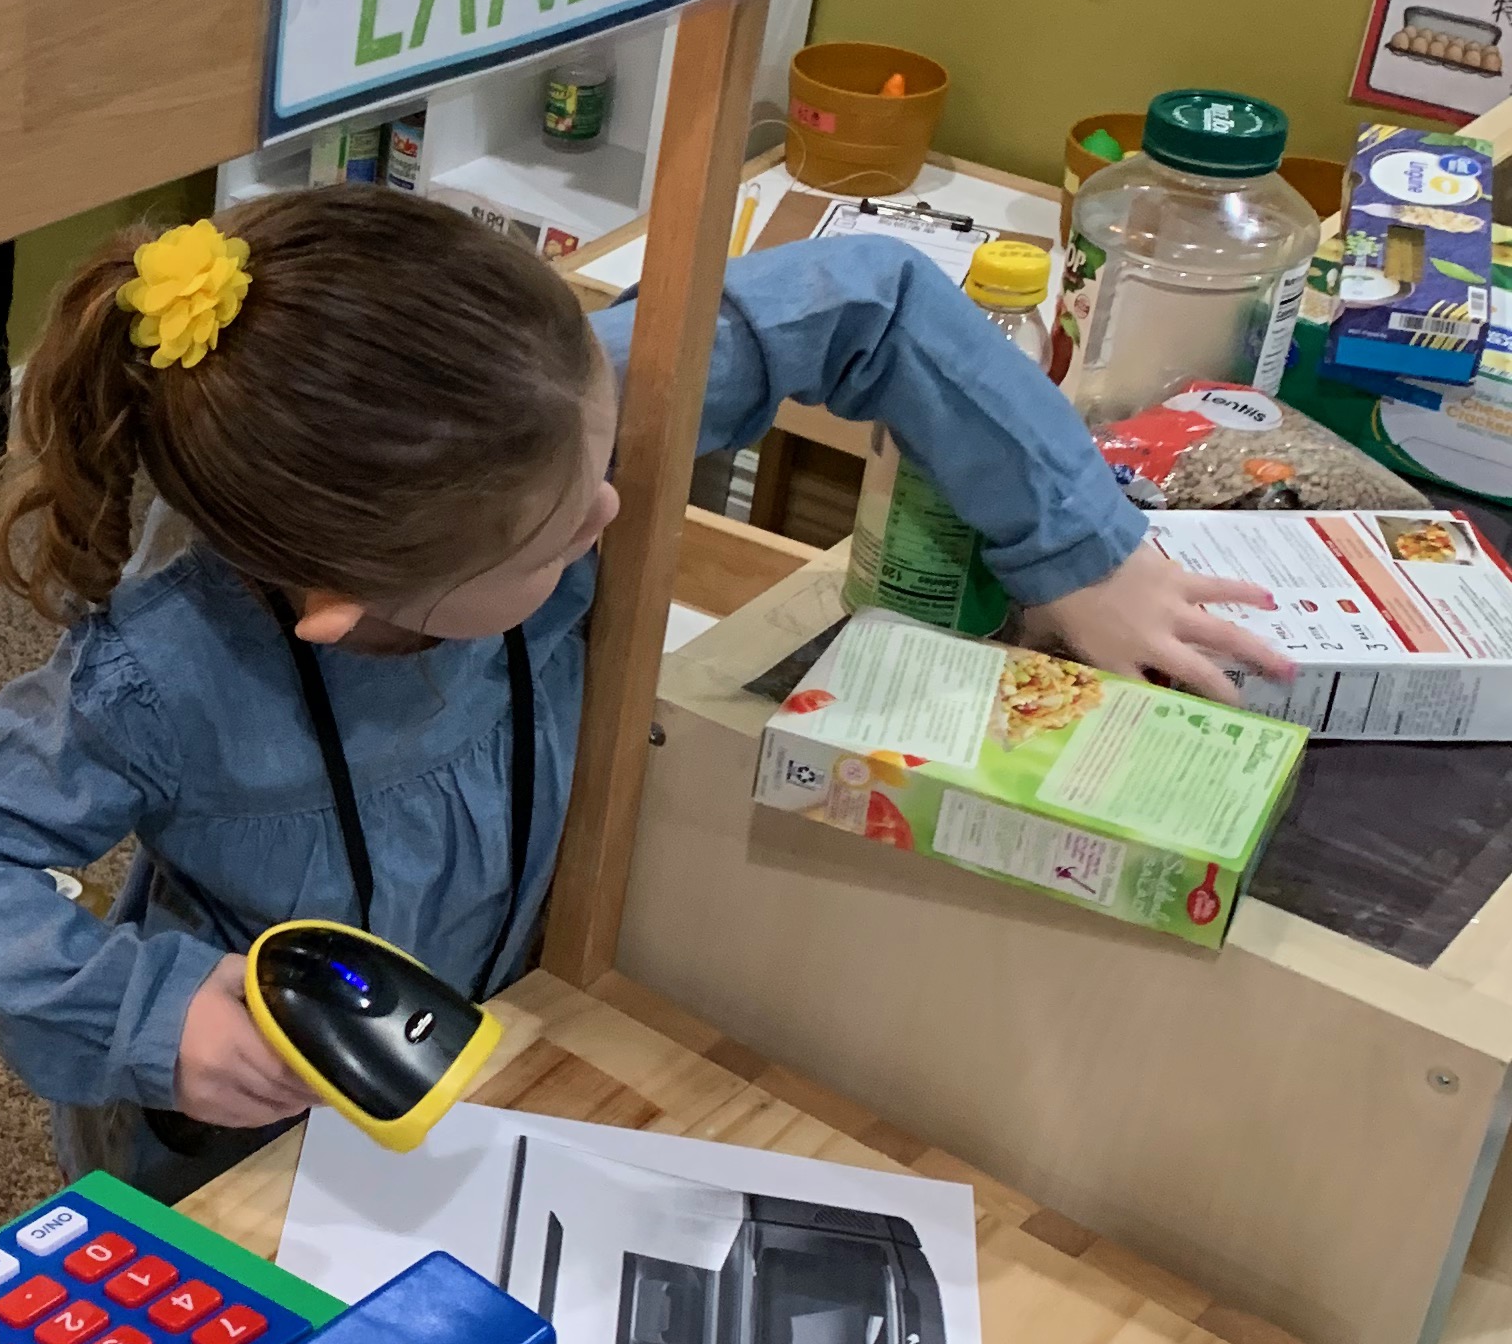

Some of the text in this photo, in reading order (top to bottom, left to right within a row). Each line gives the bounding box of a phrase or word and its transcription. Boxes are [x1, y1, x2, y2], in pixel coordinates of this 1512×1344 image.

[1404, 161, 1429, 194] Linguine
[881, 564, 903, 583] 120
[31, 1212, 72, 1241] ON/C
[126, 1270, 152, 1288] 1
[171, 1293, 195, 1311] 4
[58, 1311, 85, 1332] 2
[219, 1317, 246, 1337] 7
